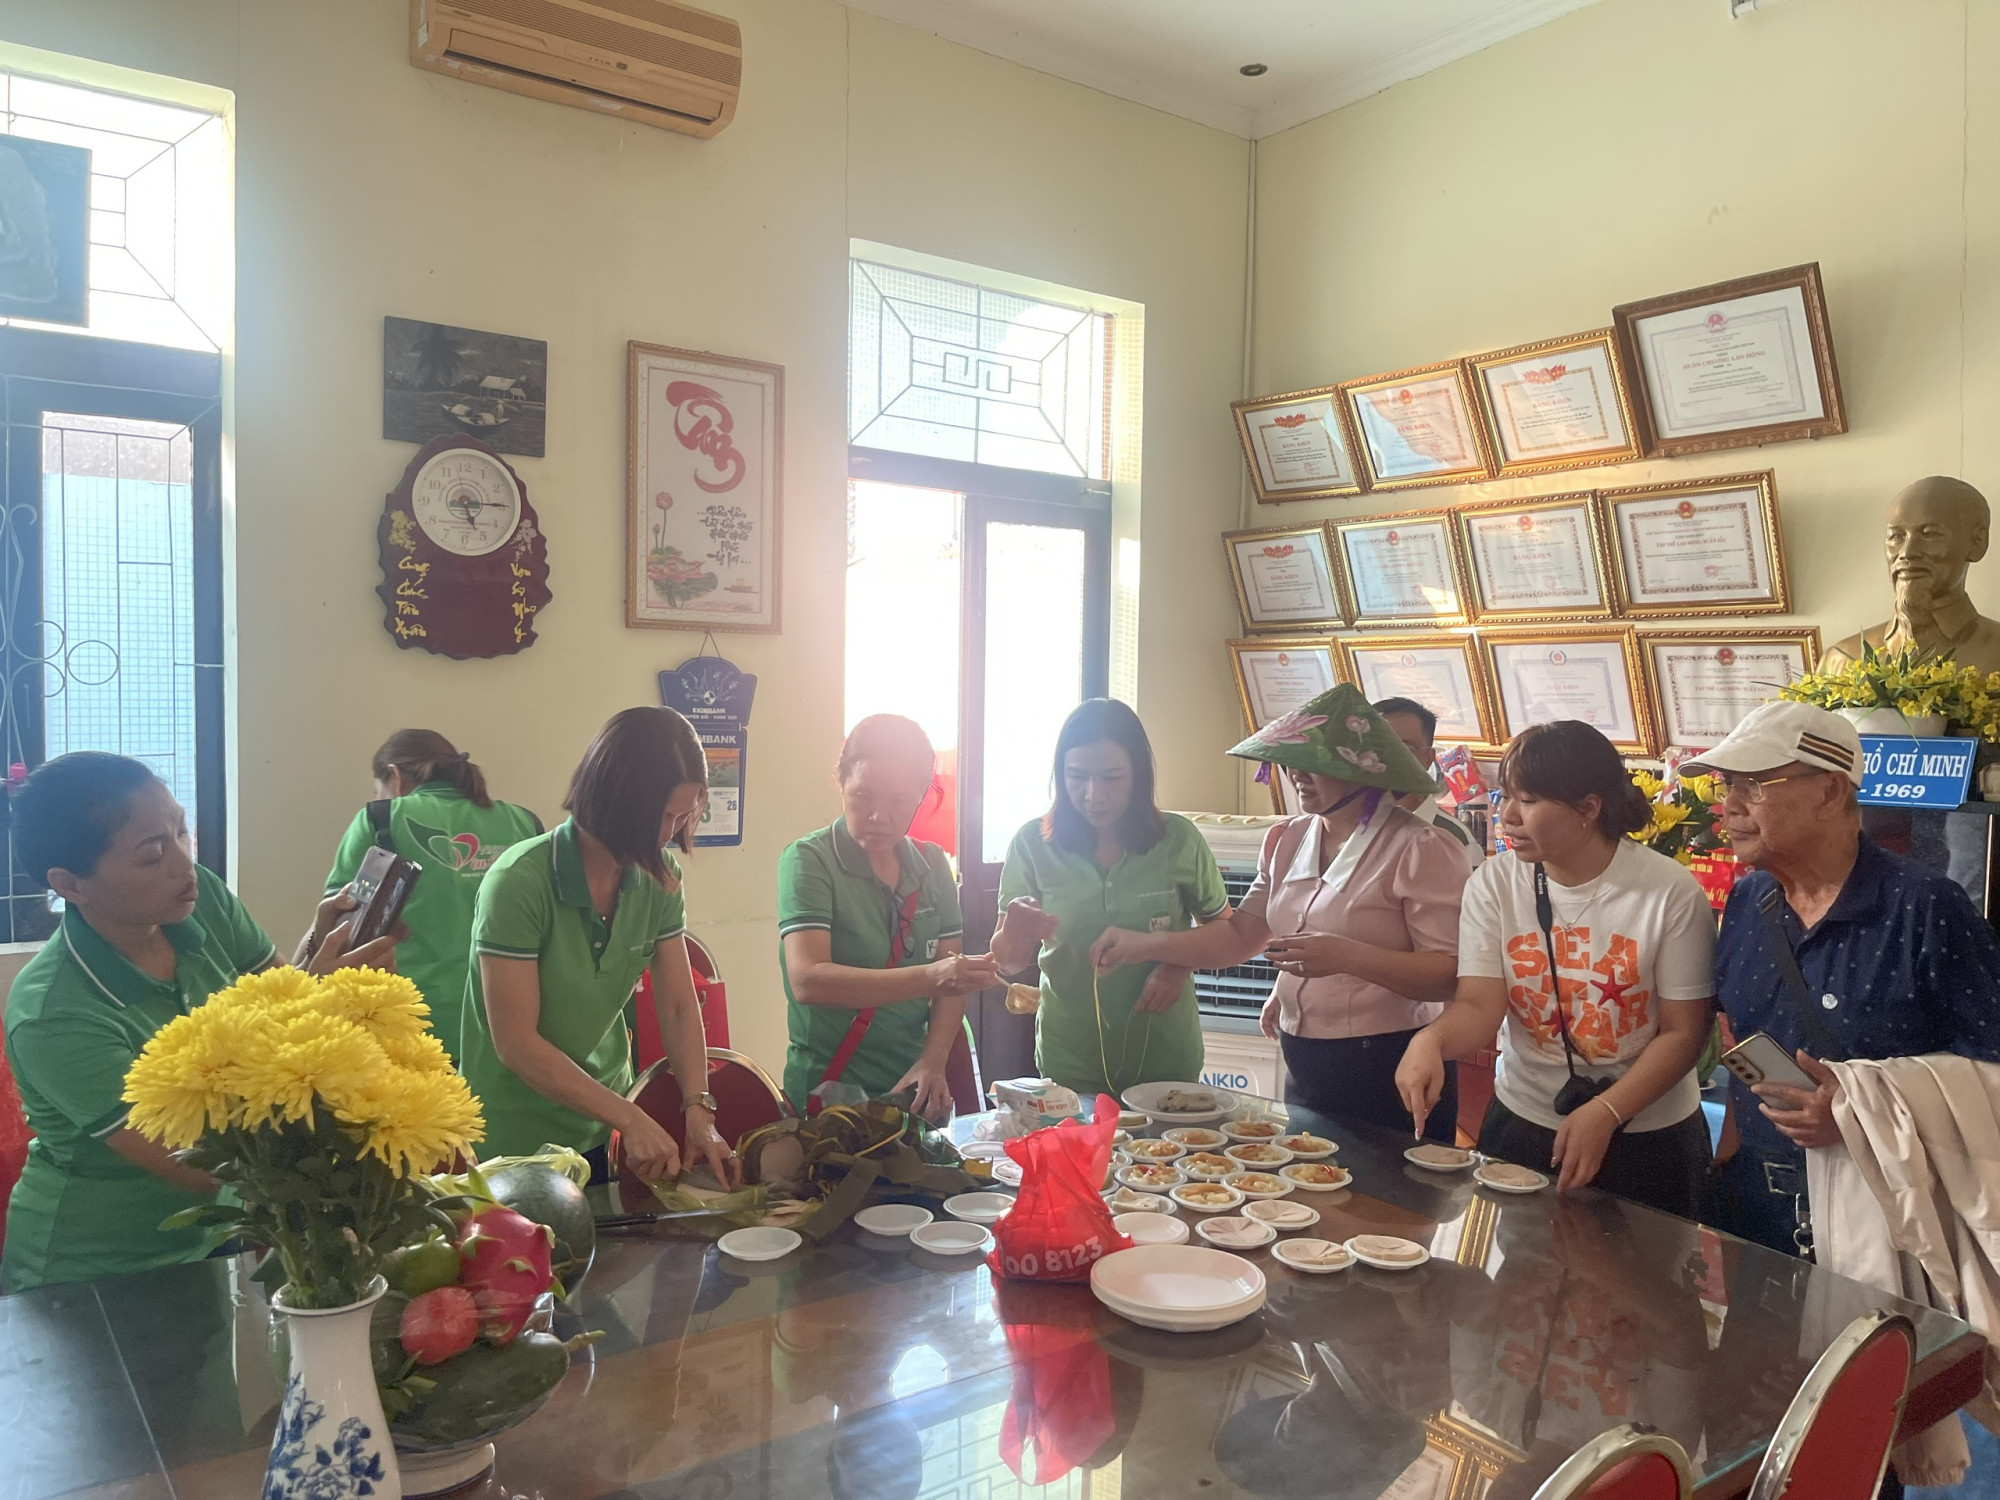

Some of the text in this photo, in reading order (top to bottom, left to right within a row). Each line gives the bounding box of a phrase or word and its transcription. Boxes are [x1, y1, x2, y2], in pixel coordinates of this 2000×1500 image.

[442, 467, 451, 477] 11
[458, 462, 472, 472] 12
[480, 468, 486, 480] 1
[429, 480, 440, 490] 10
[493, 483, 501, 492] 2
[422, 496, 430, 506] 9
[428, 515, 436, 524] 8
[491, 519, 500, 528] 4
[443, 528, 450, 539] 7
[479, 531, 487, 542] 5
[461, 534, 468, 545] 6
[396, 600, 420, 616] Tân
[698, 734, 736, 744] MBANK
[1886, 747, 1918, 776] CHÍ
[1919, 755, 1968, 778] MINH
[1870, 783, 1926, 799] 1969
[727, 800, 738, 811] 26
[1506, 925, 1642, 985] SEA
[1509, 974, 1650, 1054] STAR
[1200, 1072, 1248, 1088] AIKIO
[1005, 1234, 1103, 1276] 00 8123
